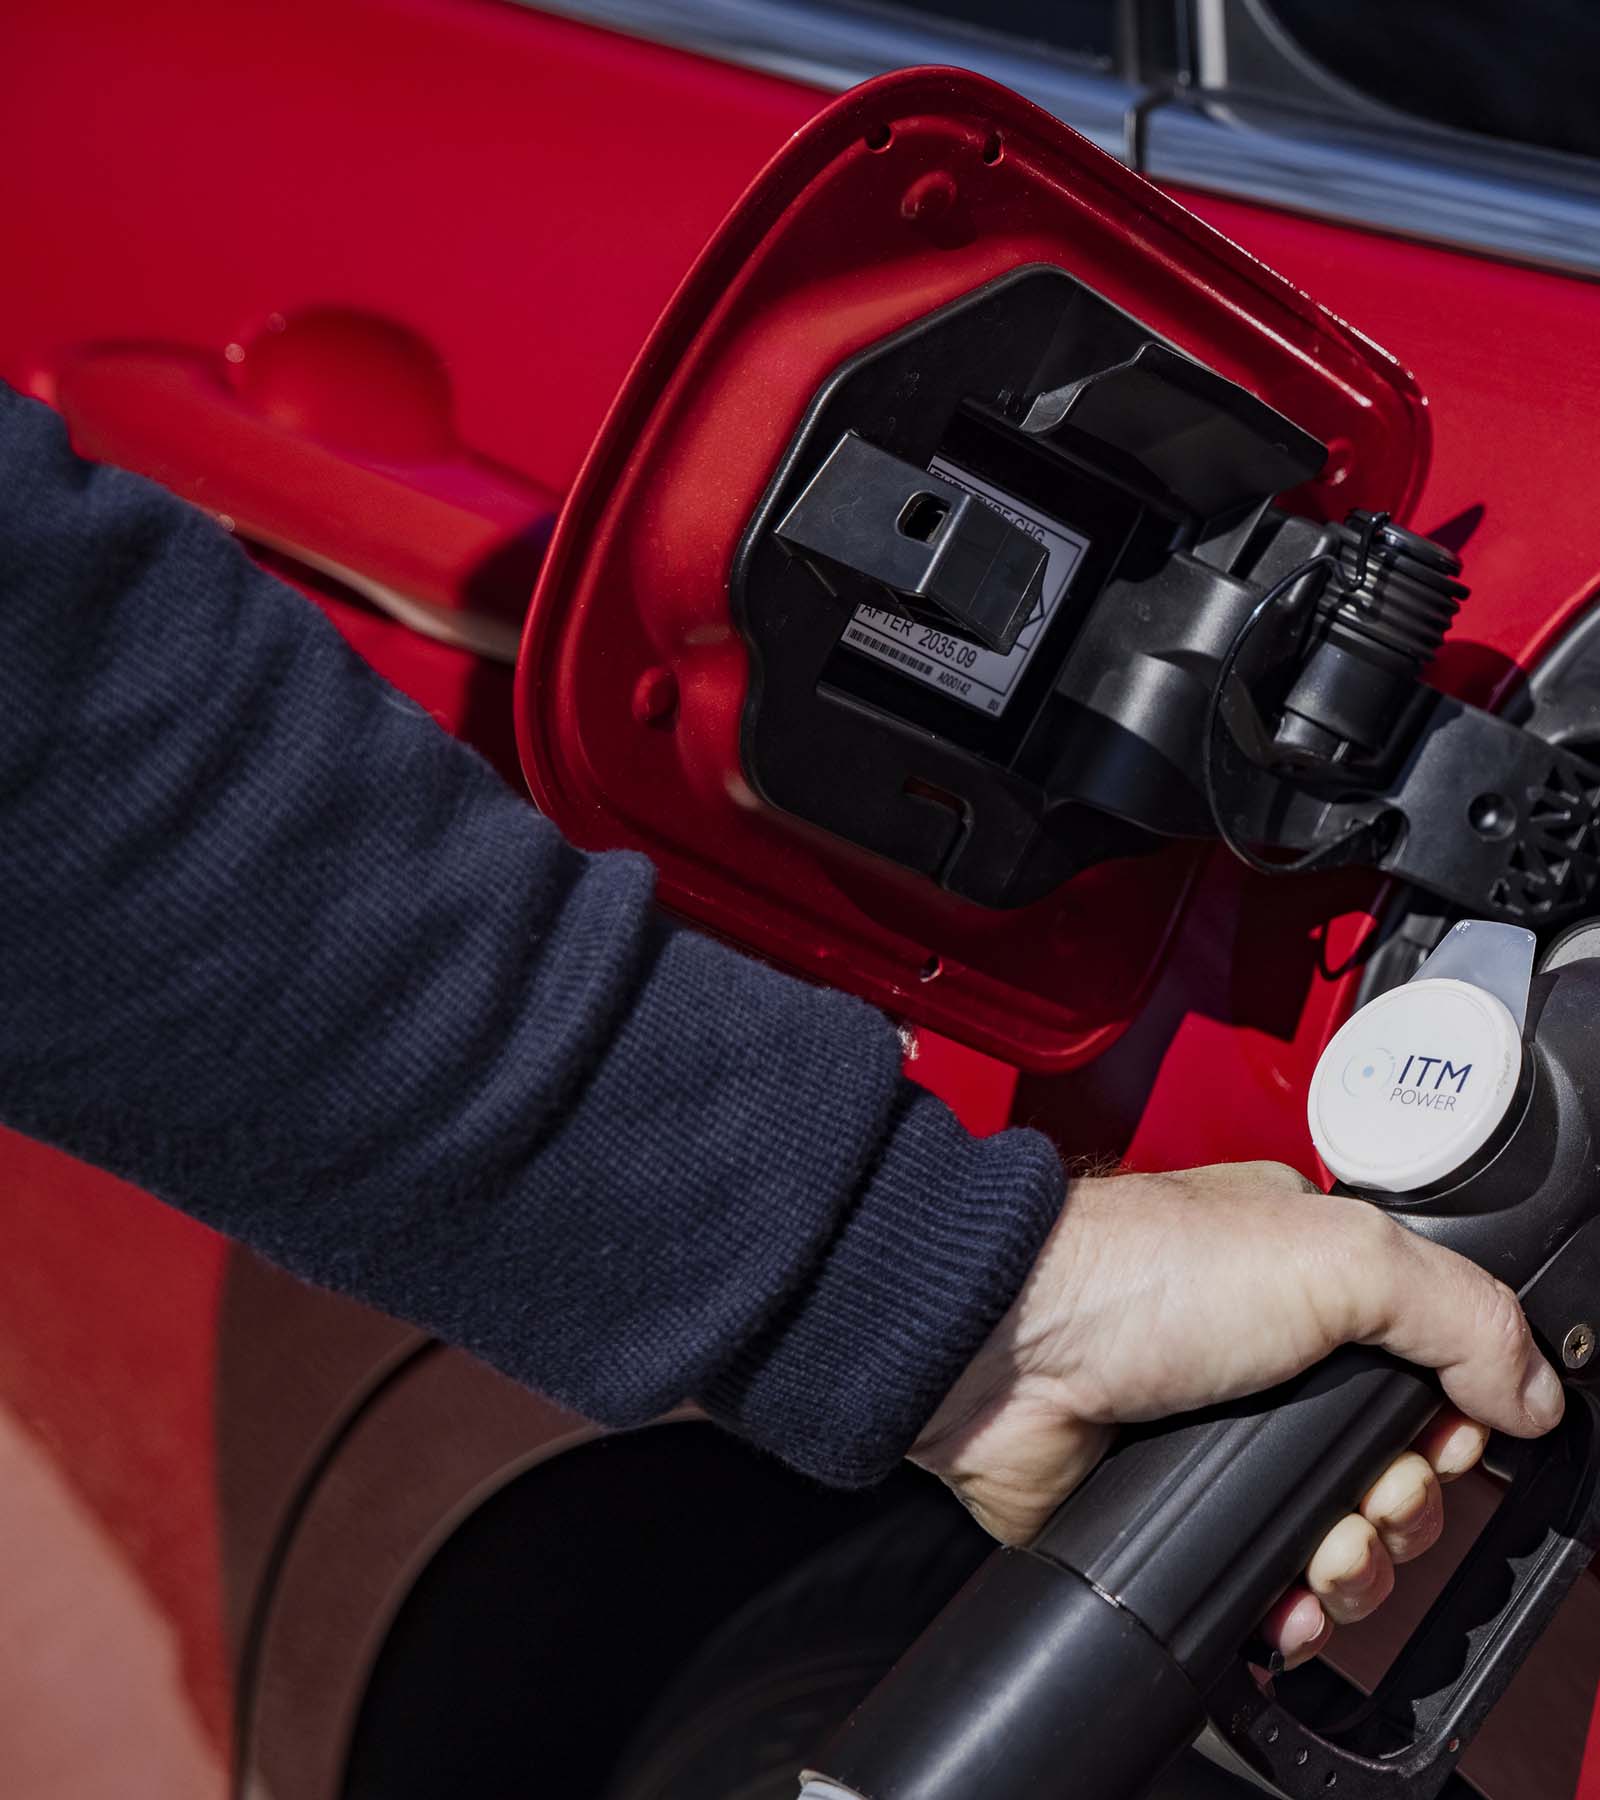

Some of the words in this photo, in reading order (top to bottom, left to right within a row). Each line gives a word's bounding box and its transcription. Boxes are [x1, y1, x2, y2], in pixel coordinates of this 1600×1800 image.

[860, 606, 914, 637] AFTER
[918, 628, 977, 669] 2035.09
[1398, 1055, 1472, 1093] ITM
[1390, 1087, 1457, 1112] POWER
